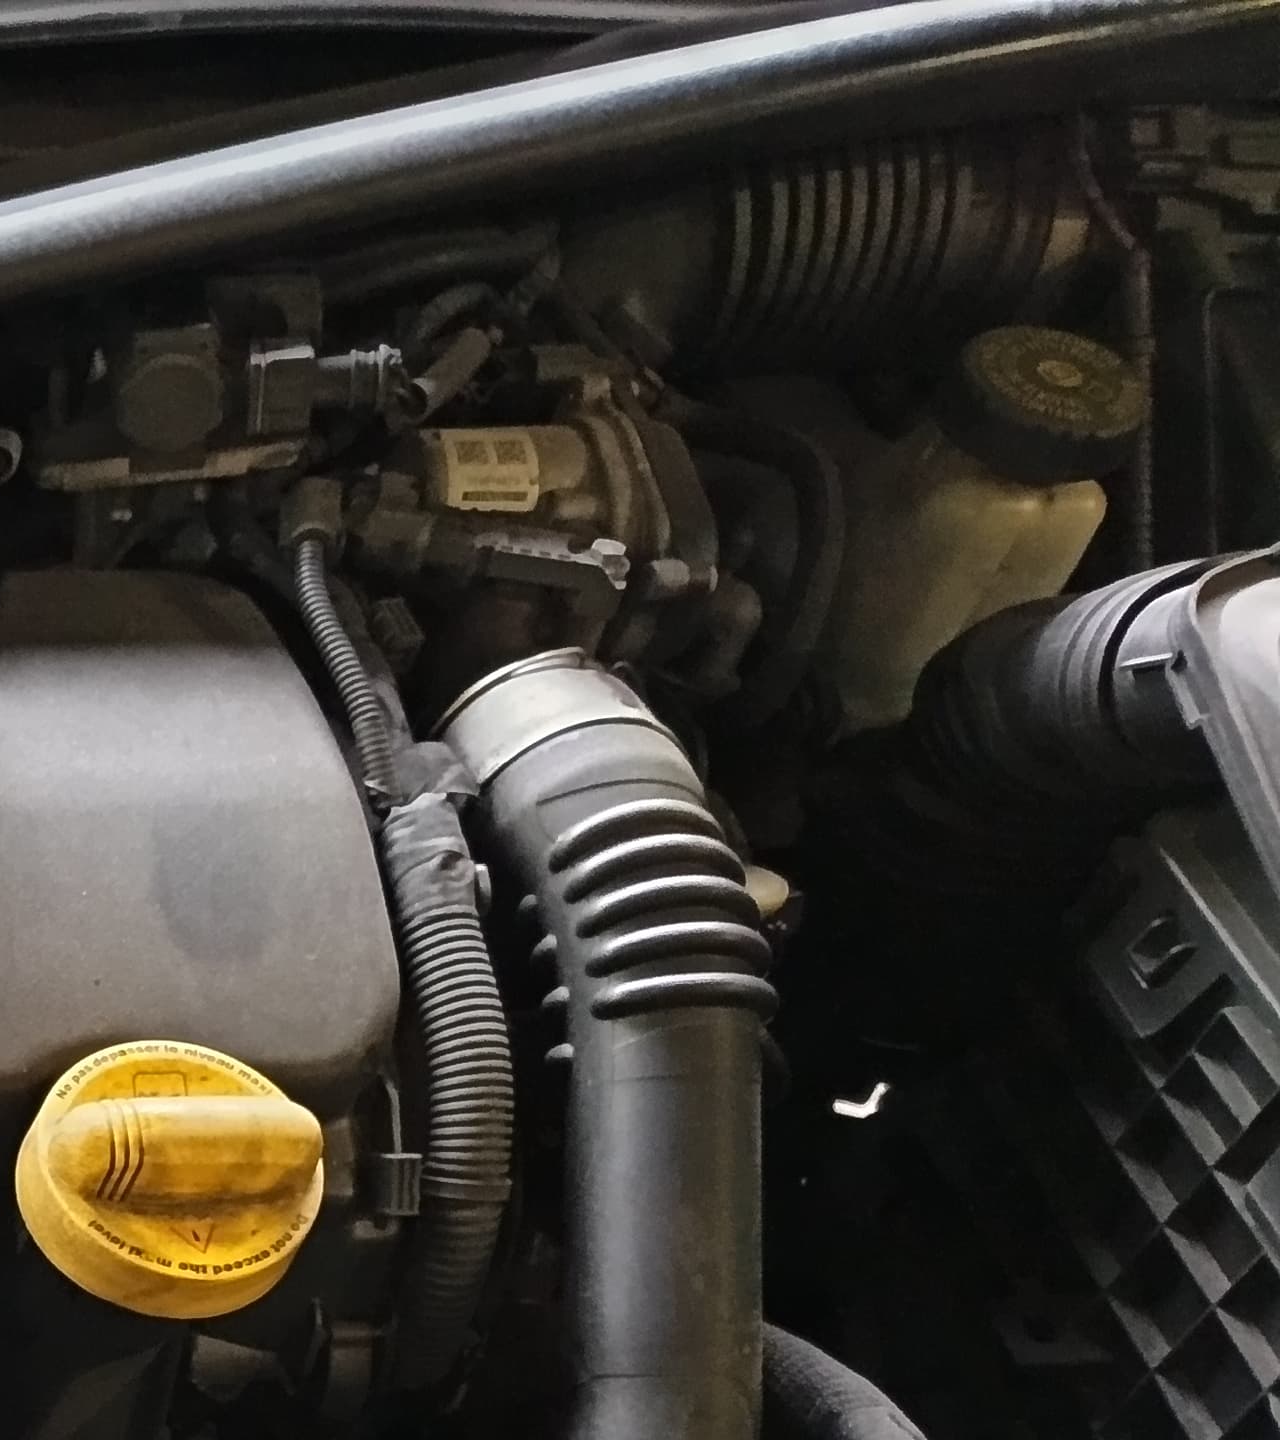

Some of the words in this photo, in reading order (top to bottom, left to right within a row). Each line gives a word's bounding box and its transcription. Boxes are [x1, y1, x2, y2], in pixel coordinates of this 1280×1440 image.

[71, 1064, 93, 1085] pas
[269, 1231, 293, 1254] not
[178, 1261, 208, 1275] the
[213, 1249, 271, 1276] exceed
